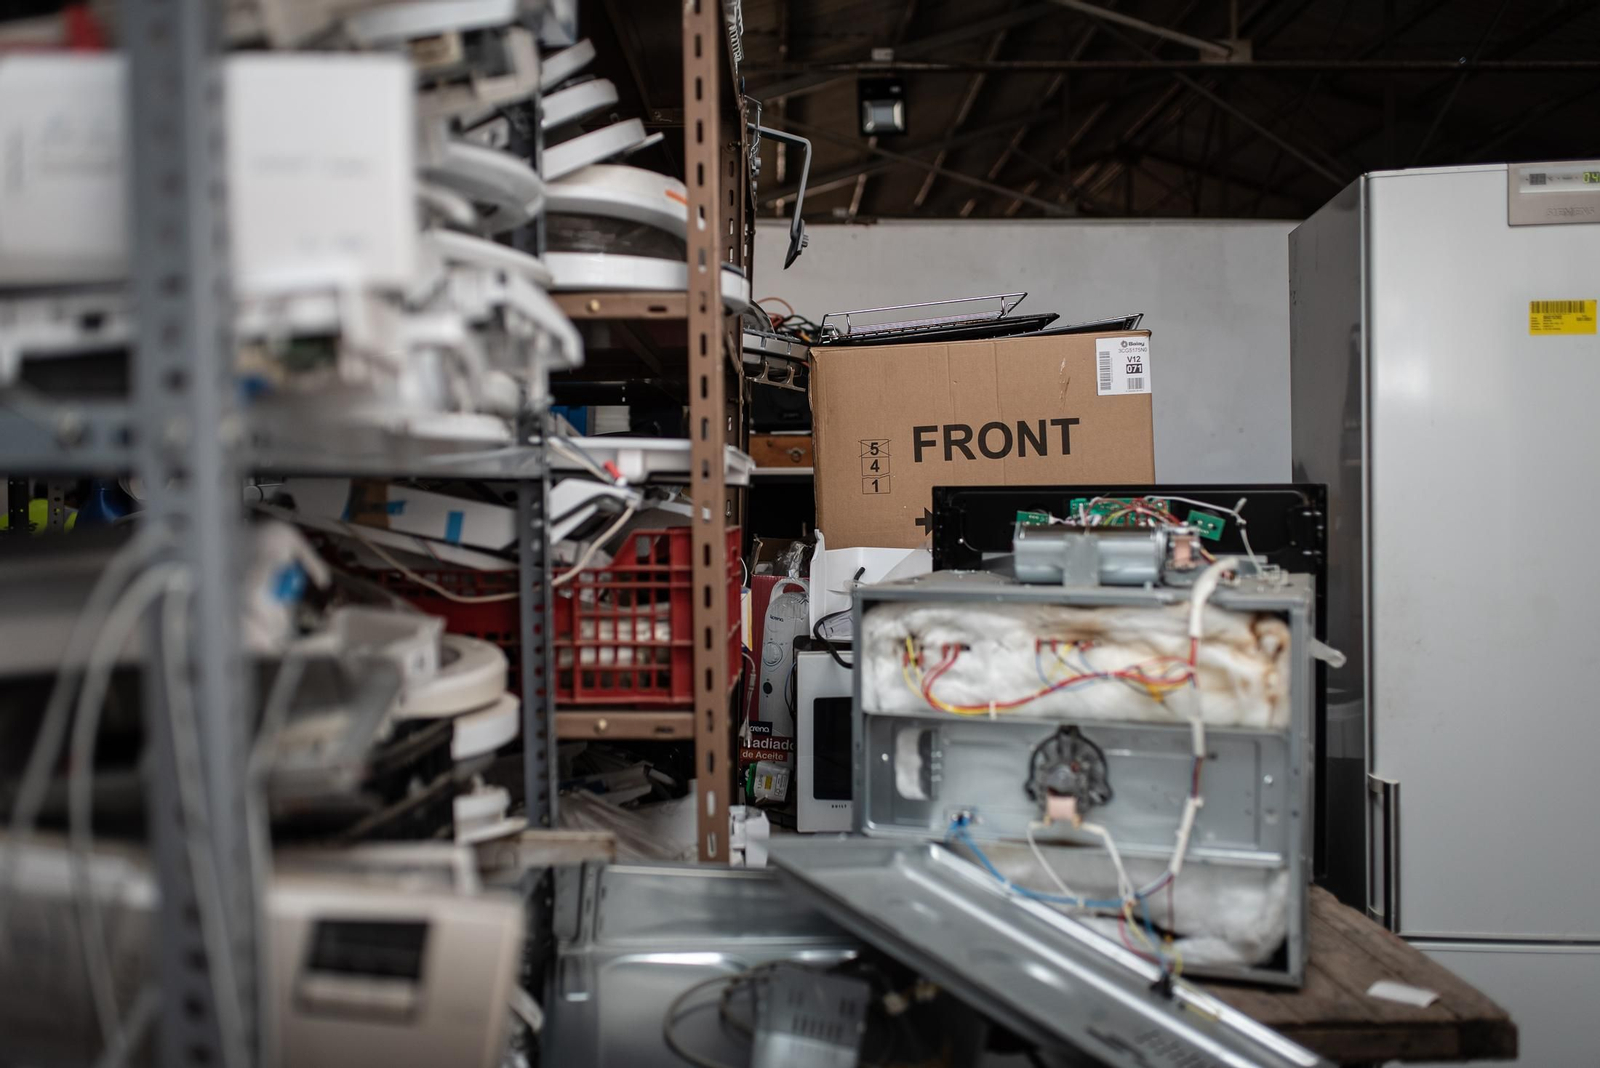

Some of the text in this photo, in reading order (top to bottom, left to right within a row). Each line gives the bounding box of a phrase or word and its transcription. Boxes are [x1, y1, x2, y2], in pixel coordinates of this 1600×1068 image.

[1547, 206, 1595, 217] SIEMENS
[1126, 355, 1141, 363] V12
[1126, 365, 1142, 373] 071
[912, 417, 1080, 463] FRONT
[870, 442, 879, 456] 5
[870, 459, 880, 472] 4
[871, 479, 879, 493] 1
[742, 750, 784, 761] de Aceite
